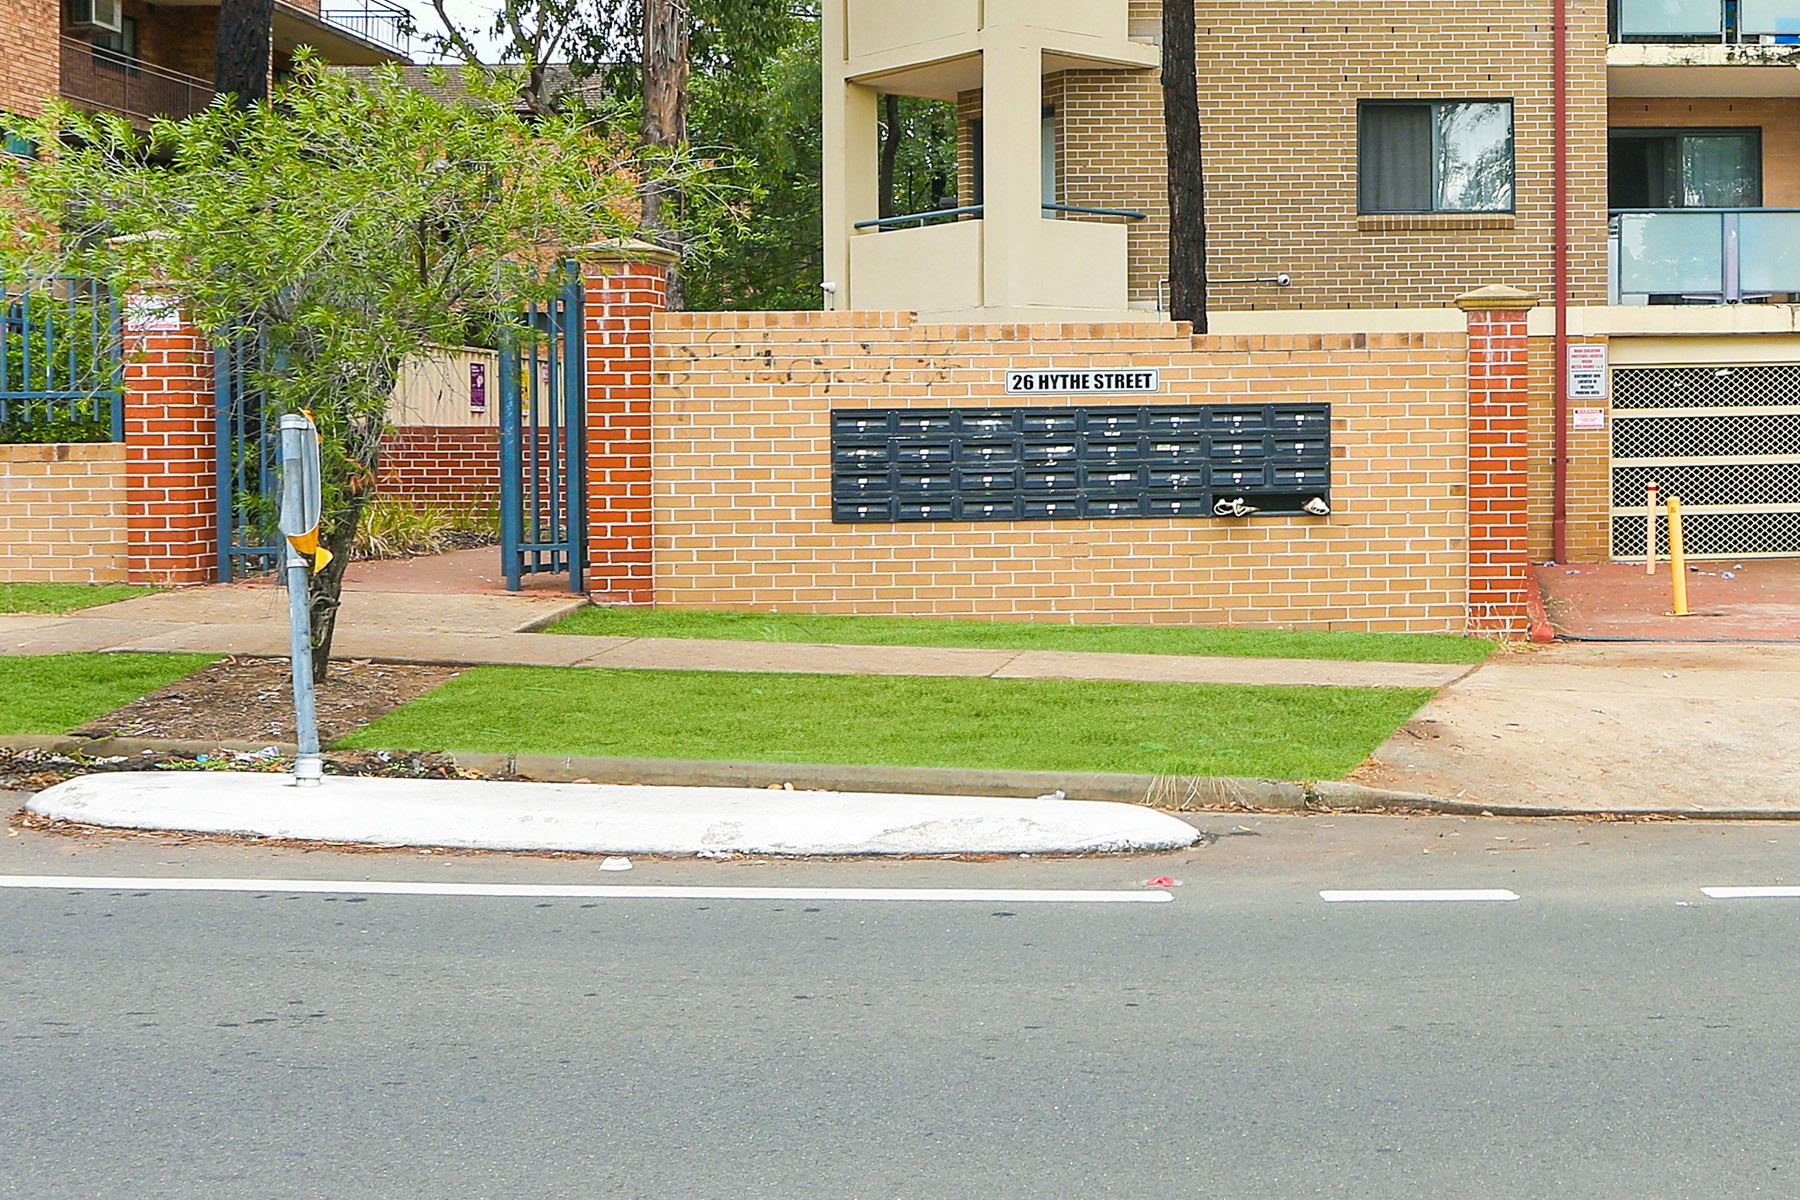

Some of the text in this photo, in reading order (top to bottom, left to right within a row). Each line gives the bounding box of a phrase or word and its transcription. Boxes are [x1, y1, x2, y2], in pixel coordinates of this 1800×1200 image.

[1012, 373, 1152, 390] 26 HYTHE STREET
